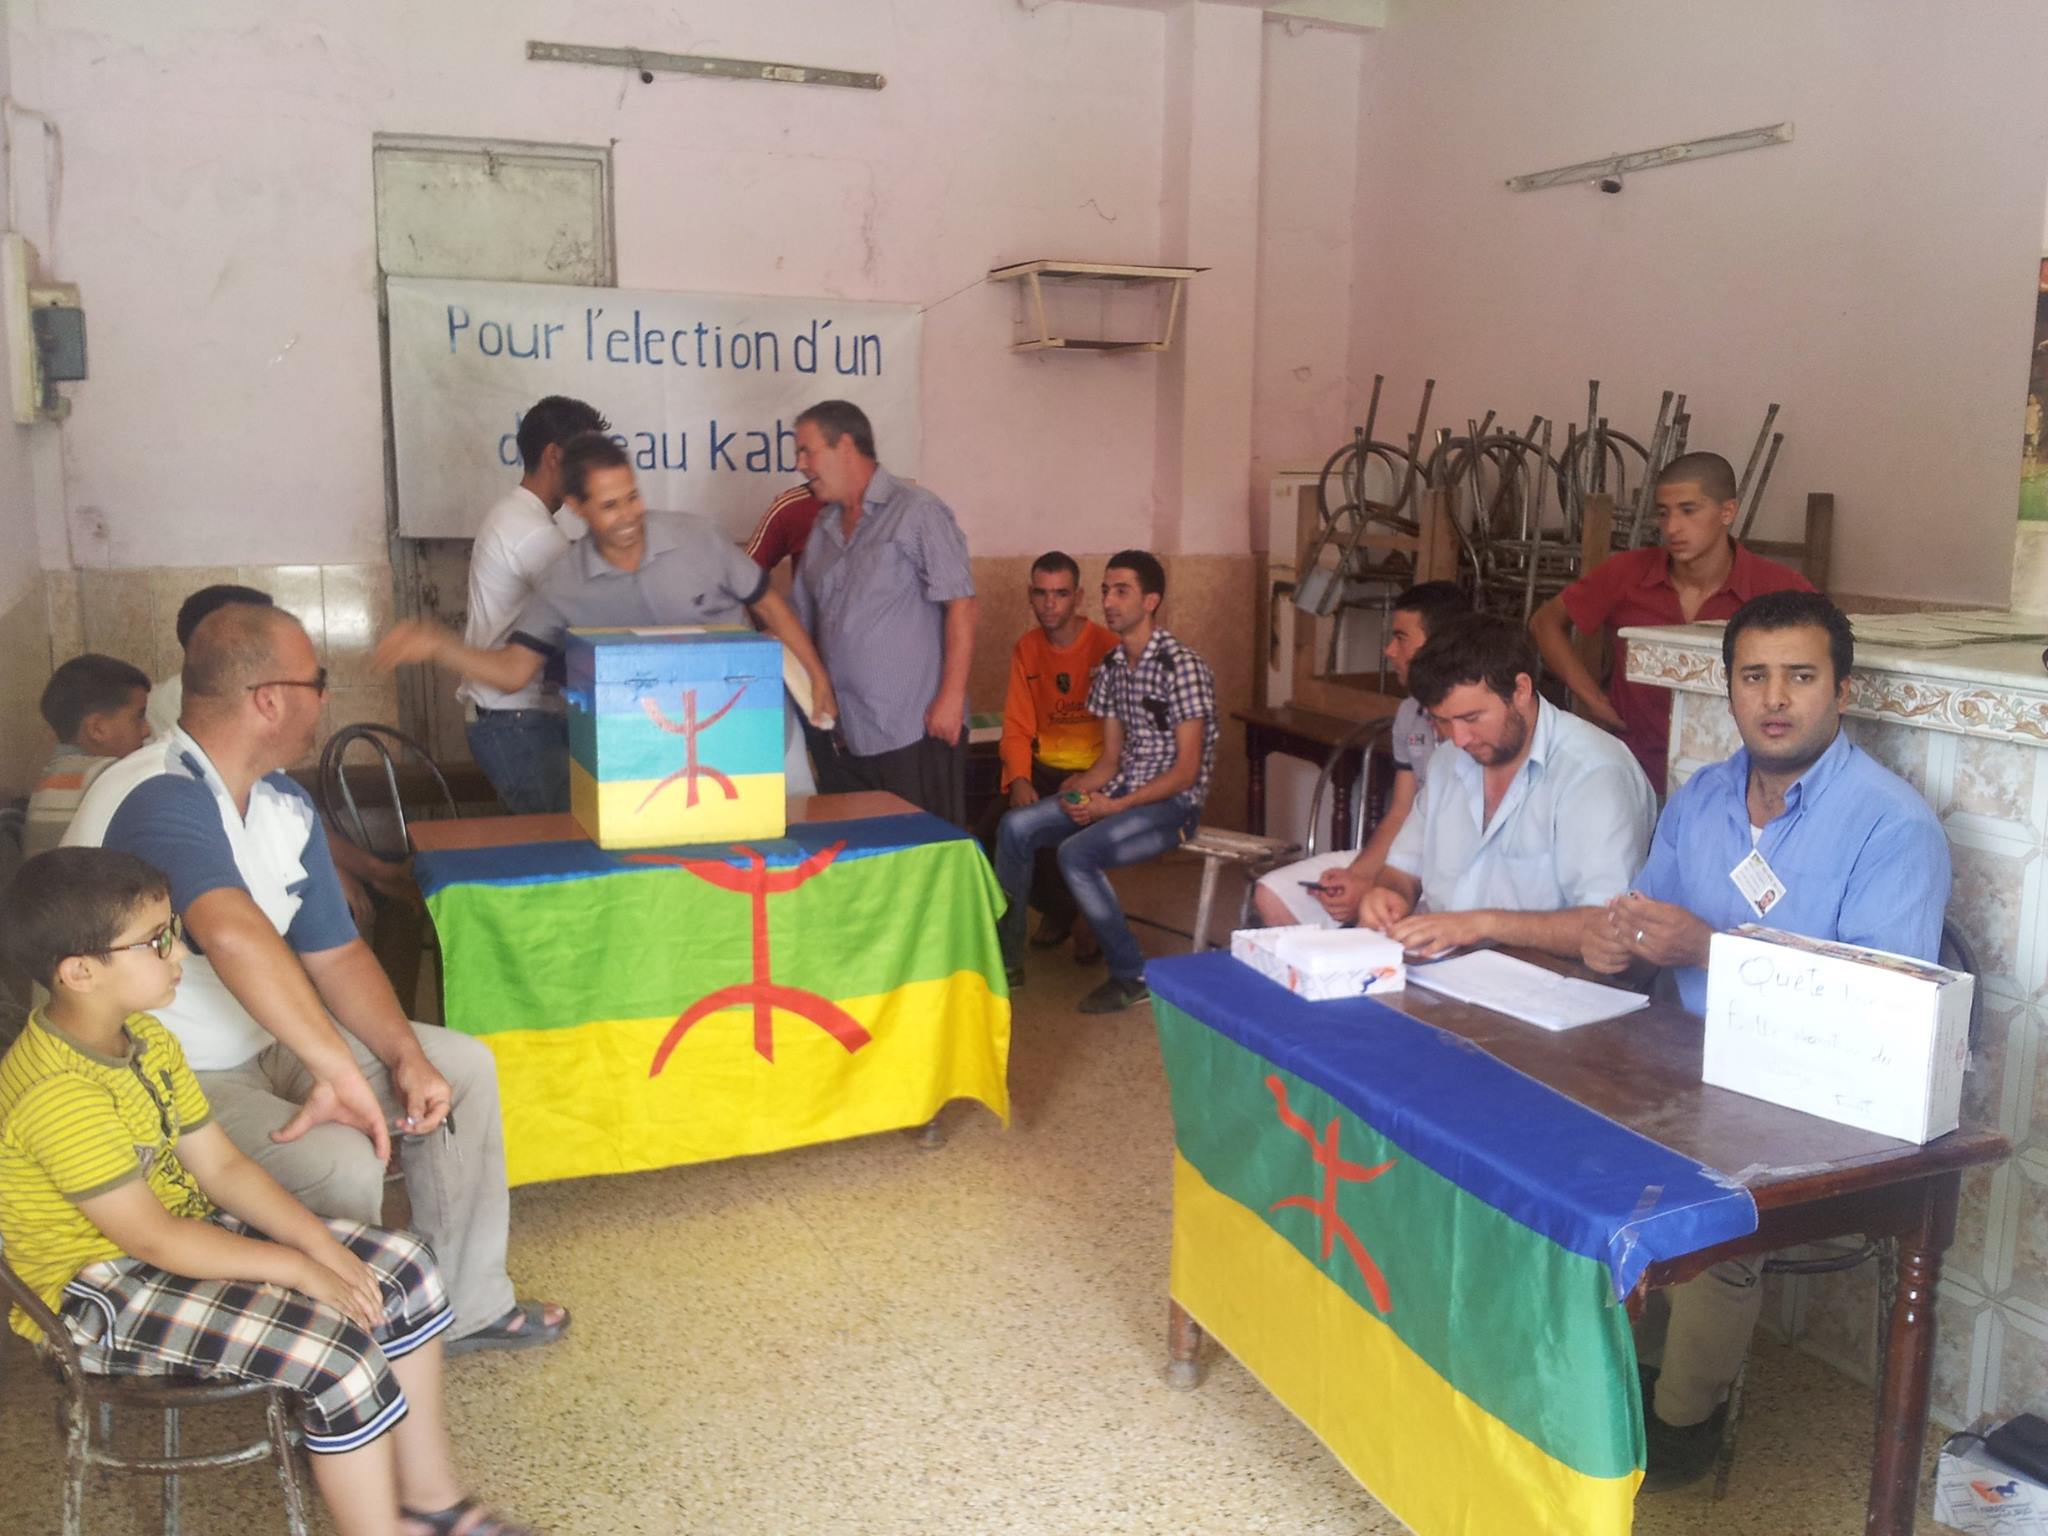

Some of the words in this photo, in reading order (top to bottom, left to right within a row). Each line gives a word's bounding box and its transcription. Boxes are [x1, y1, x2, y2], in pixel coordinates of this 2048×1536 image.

[447, 304, 565, 360] Pour
[586, 307, 779, 373] l'election
[794, 318, 882, 376] d'un
[709, 419, 798, 473] kab
